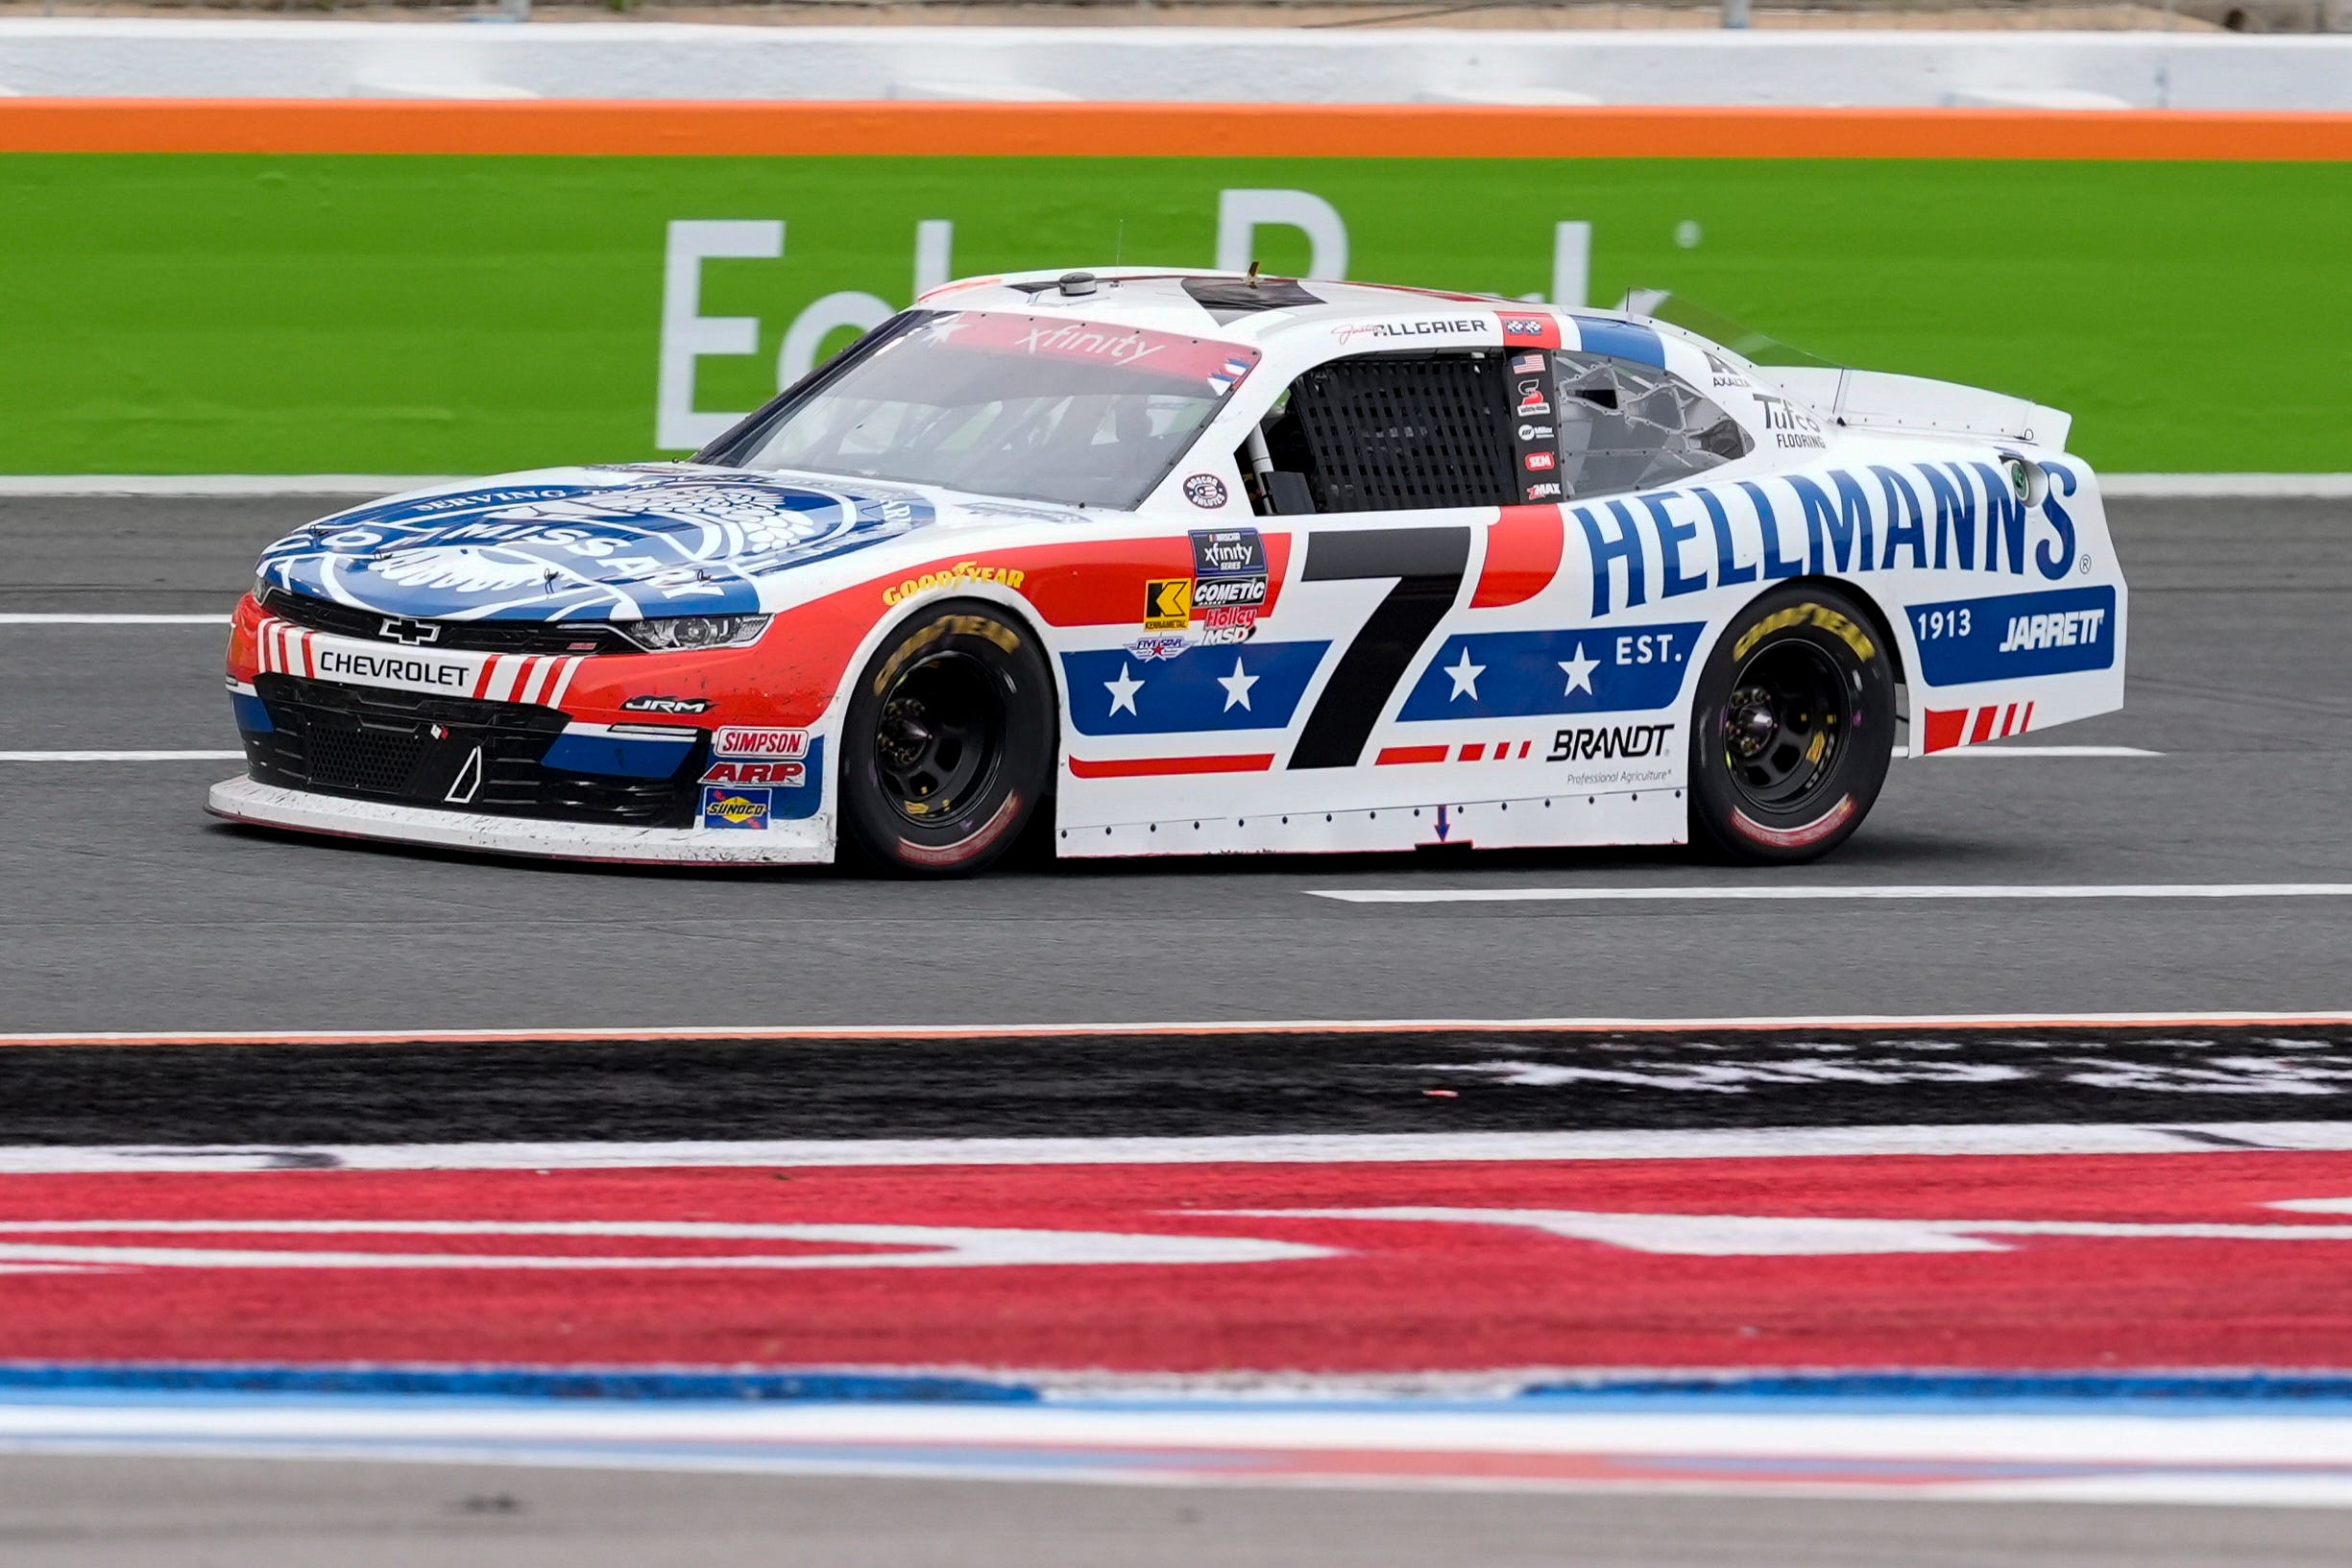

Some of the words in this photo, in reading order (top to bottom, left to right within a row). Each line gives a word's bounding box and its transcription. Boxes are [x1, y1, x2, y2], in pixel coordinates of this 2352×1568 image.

[1013, 324, 1167, 367] xfinity
[1776, 433, 1826, 449] FLOORING
[1203, 543, 1253, 567] xfinity
[882, 560, 1026, 606] GOODYEAR
[1194, 578, 1266, 603] COMETIC
[1206, 606, 1258, 631] Holley
[1918, 608, 1972, 640] 1913
[1999, 608, 2105, 653] JARRETT
[1204, 627, 1250, 645] MSD
[1285, 526, 1471, 771] 7
[1615, 633, 1684, 665] EST.
[319, 650, 472, 688] CHEVROLET
[624, 699, 708, 714] JRM
[722, 732, 803, 754] SIMPSON
[1545, 723, 1676, 763] BRANDT
[702, 762, 805, 784] ARP
[1566, 770, 1619, 786] Professional
[708, 803, 766, 815] SUNOCO
